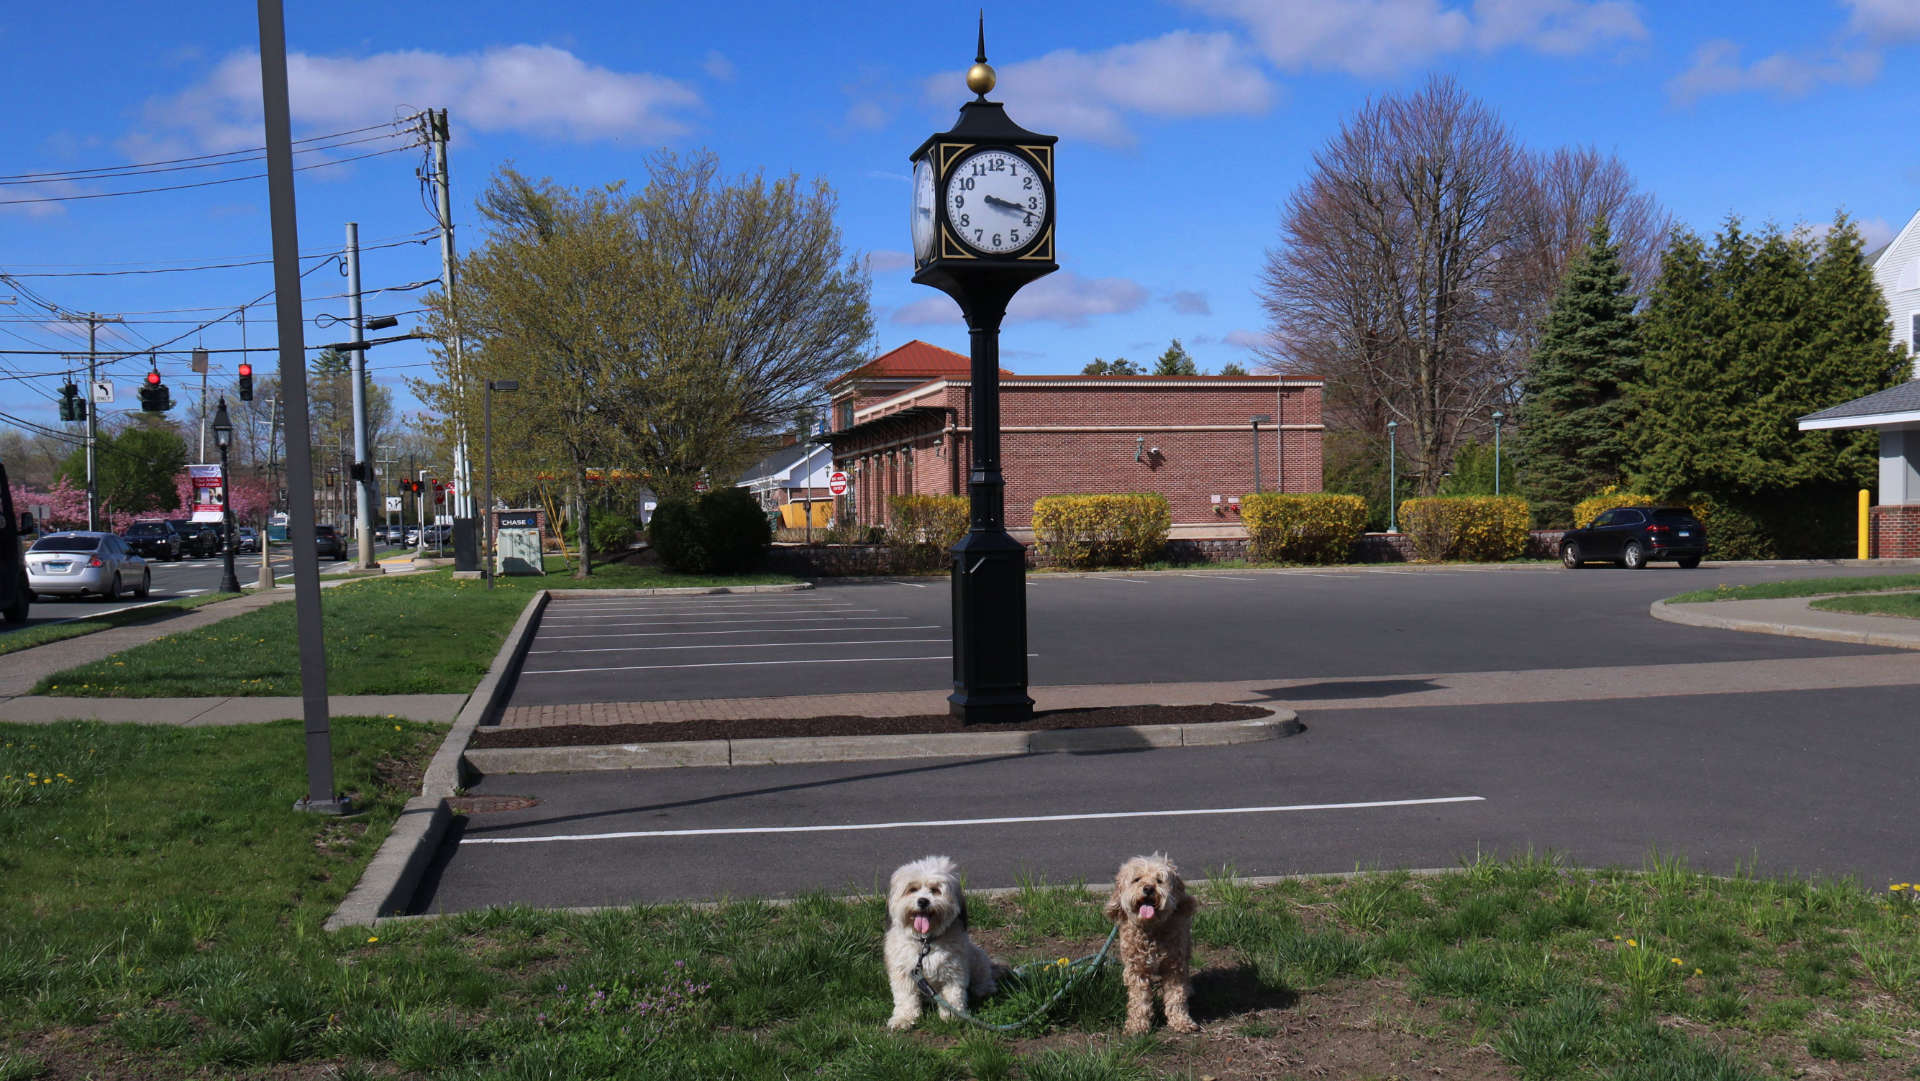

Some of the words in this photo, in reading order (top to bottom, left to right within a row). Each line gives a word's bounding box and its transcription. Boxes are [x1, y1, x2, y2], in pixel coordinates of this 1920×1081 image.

[971, 163, 986, 176] 11
[988, 158, 1004, 171] 12
[1010, 163, 1017, 176] 1
[959, 177, 975, 190] 10
[1023, 177, 1032, 190] 2
[955, 195, 964, 208] 9
[1028, 196, 1037, 209] 3
[960, 214, 969, 227] 8
[1023, 213, 1032, 227] 4
[974, 229, 983, 242] 7
[992, 233, 1001, 246] 6
[1010, 229, 1019, 242] 5
